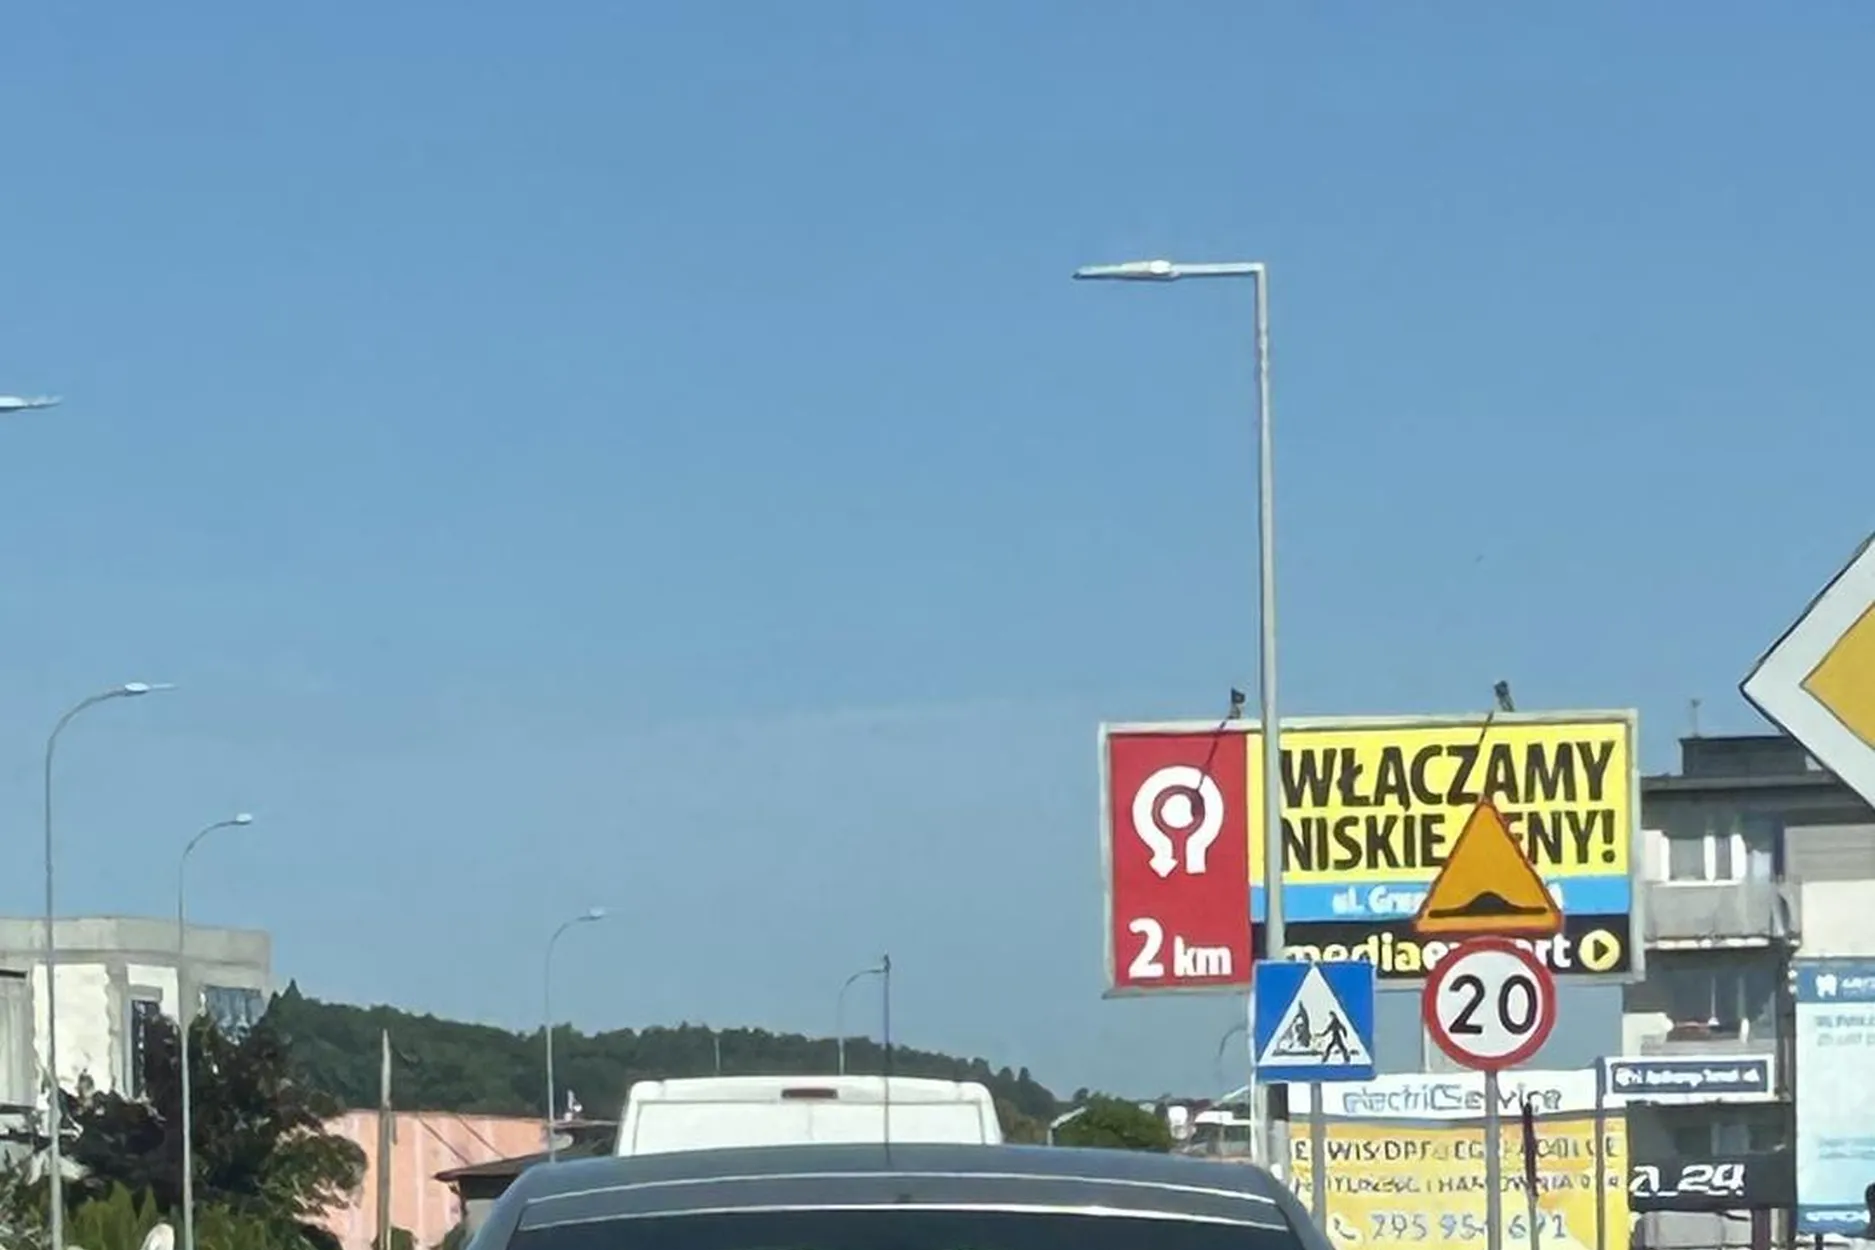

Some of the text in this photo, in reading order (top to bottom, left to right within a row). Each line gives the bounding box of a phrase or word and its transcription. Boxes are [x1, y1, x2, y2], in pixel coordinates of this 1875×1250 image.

[1280, 741, 1615, 811] WŁĄCZAMY
[1281, 814, 1448, 872] NISKIE
[1129, 917, 1232, 979] 2 km
[1449, 974, 1538, 1035] 20
